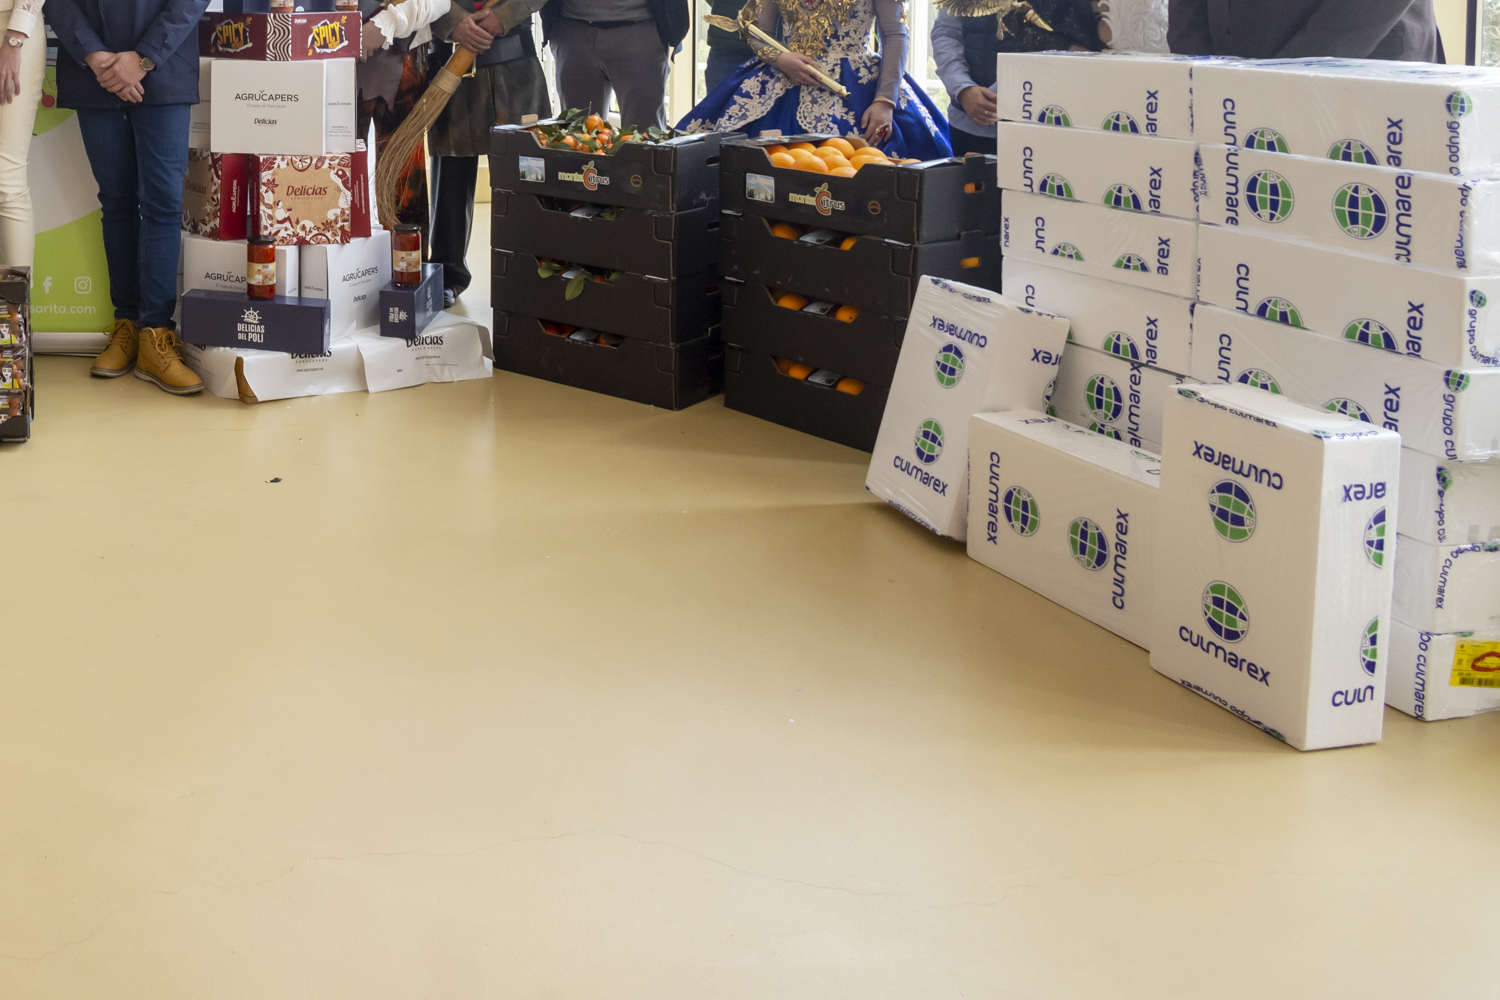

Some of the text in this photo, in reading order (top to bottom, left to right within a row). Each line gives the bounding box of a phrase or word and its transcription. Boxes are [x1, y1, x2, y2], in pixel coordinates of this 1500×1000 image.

[216, 22, 244, 45] SPICY
[312, 22, 340, 47] SPICY
[235, 92, 300, 102] AGRUCAPERS
[1146, 89, 1158, 136] arex
[1446, 120, 1460, 163] grupo
[286, 185, 328, 196] Delicias
[1148, 166, 1162, 214] arex
[204, 271, 246, 284] AGRUCAP
[342, 266, 378, 283] AGRUCAPERS
[237, 323, 265, 334] DELICIAS
[248, 333, 264, 342] POLI
[929, 315, 988, 349] culmarex
[1406, 300, 1424, 359] arex
[1468, 308, 1478, 345] grupo
[1229, 408, 1278, 429] culmarex
[1442, 394, 1458, 461] grupo cul
[893, 455, 948, 497] culmarex
[1192, 440, 1284, 490] culmarex
[986, 451, 1000, 546] culmarex
[1112, 508, 1129, 610] culmarex
[1436, 558, 1452, 610] culmarex
[1178, 625, 1271, 687] culmarex
[1414, 654, 1428, 720] culmarex
